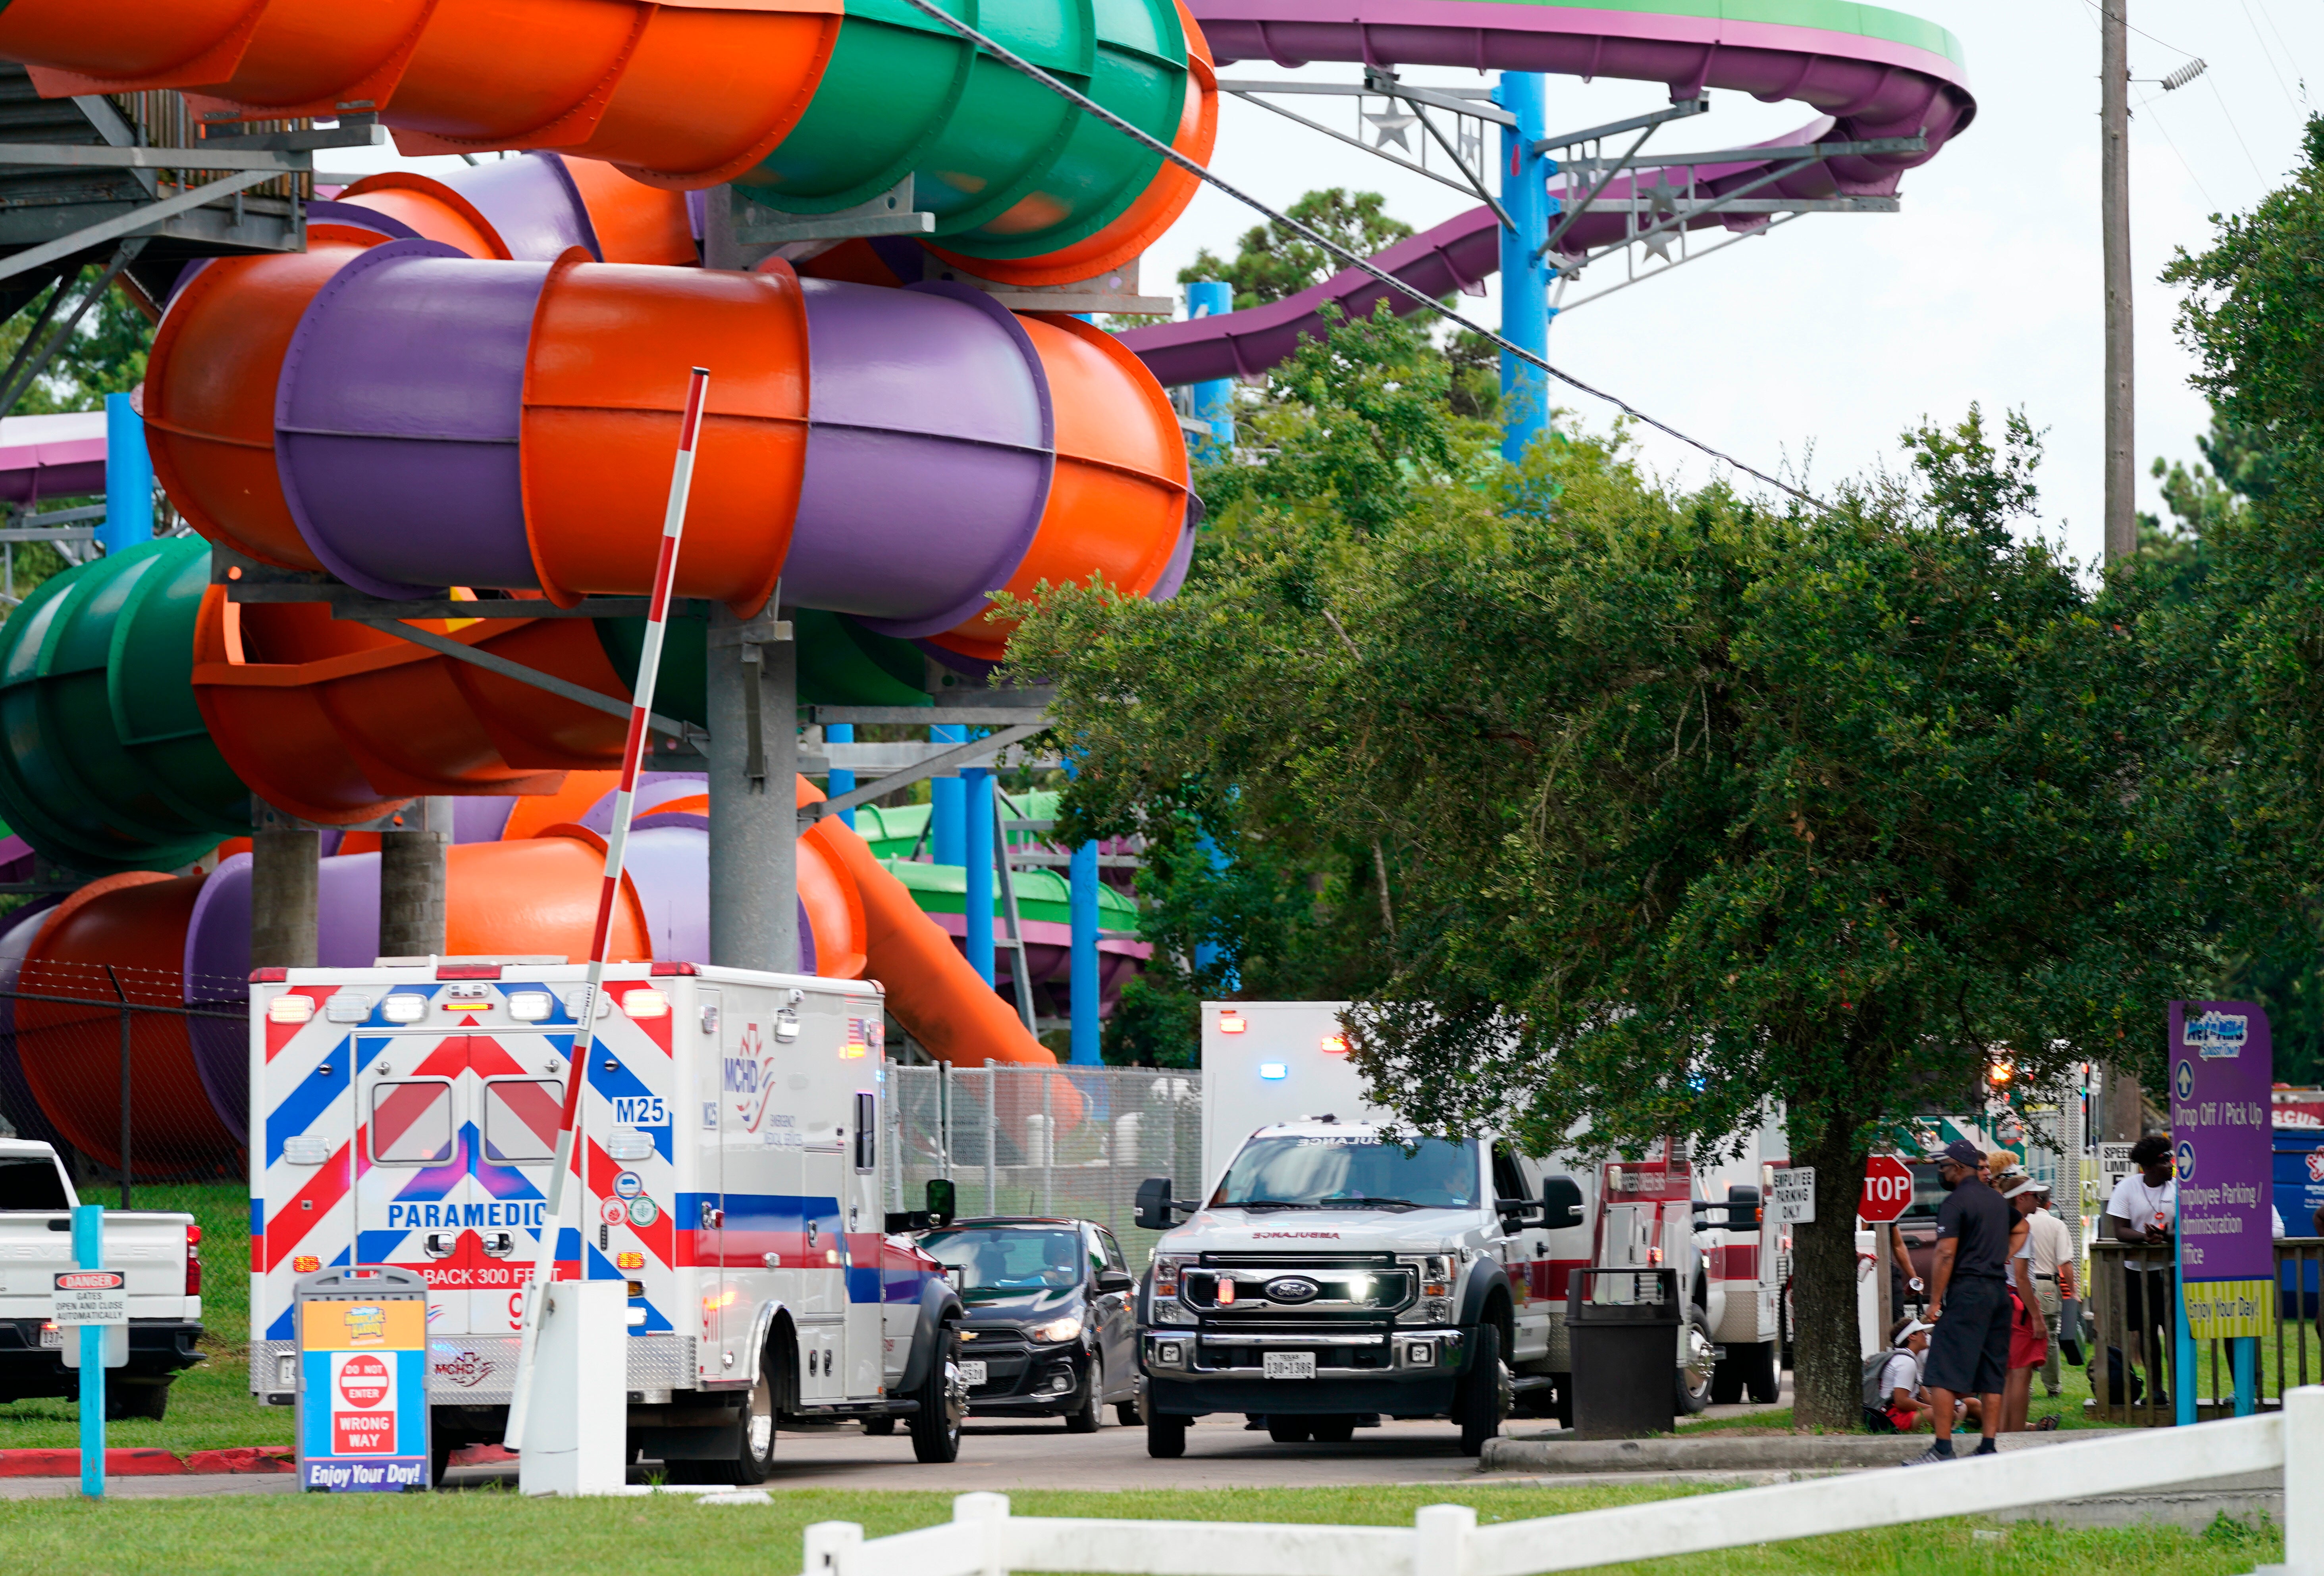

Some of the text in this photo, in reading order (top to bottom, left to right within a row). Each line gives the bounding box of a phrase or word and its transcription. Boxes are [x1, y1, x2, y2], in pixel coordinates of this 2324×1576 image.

[724, 1058, 757, 1093] MCHD
[617, 1098, 663, 1122] M25
[2175, 1103, 2199, 1132] Drop
[2200, 1102, 2216, 1126] Off
[2226, 1102, 2247, 1125] Pick
[2249, 1102, 2262, 1131] Up
[2272, 1110, 2322, 1125] SCUE
[2105, 1161, 2133, 1172] LIMIT
[1774, 1172, 1812, 1187] EMPLOYEE
[1776, 1188, 1809, 1204] PARKING
[1864, 1176, 1910, 1201] TOP
[2178, 1183, 2220, 1211] mployee
[2222, 1182, 2257, 1209] Parking
[389, 1202, 546, 1227] PARAMEDIC
[1782, 1205, 1801, 1219] ONLY
[2181, 1212, 2243, 1235] dministration
[2182, 1242, 2204, 1265] ffice
[65, 1274, 113, 1287] DANGER
[424, 1268, 562, 1285] BACK 300 FET
[77, 1292, 103, 1300] GATES
[1277, 1284, 1306, 1296] Ford
[56, 1301, 123, 1310] OPEN AND CLOSE
[2189, 1296, 2259, 1323] Enjoy Your Day!
[56, 1311, 123, 1320] AUTOMATICALLY
[345, 1365, 383, 1374] DO NOT
[435, 1364, 475, 1375] MCHD
[349, 1389, 380, 1399] ENTER
[340, 1417, 390, 1431] WRONG
[349, 1434, 380, 1447] WAY
[310, 1464, 421, 1487] Enjoy Your Day!
